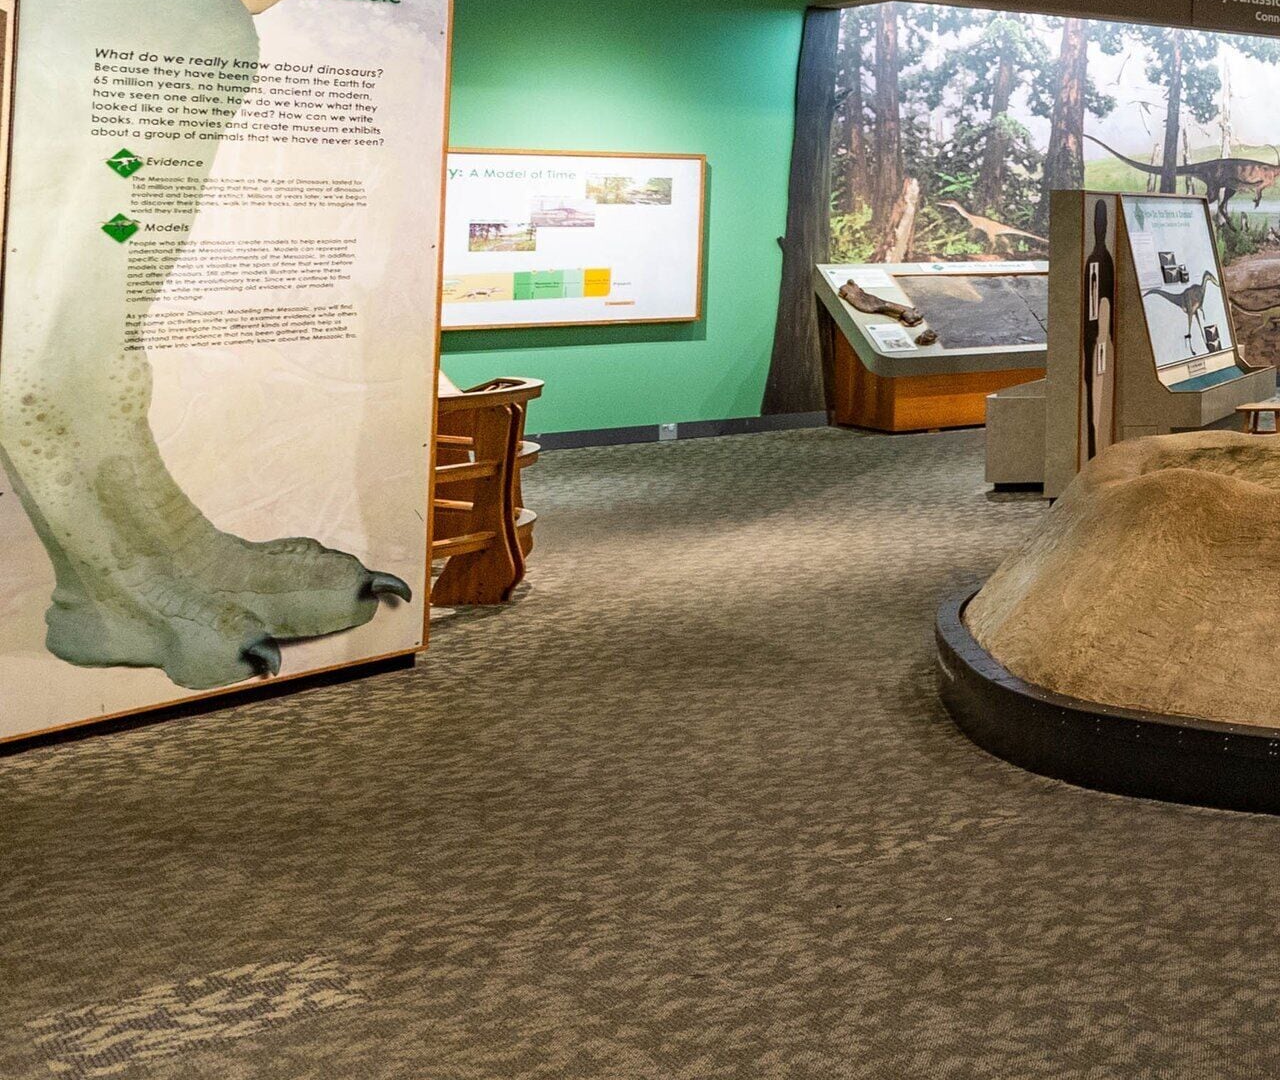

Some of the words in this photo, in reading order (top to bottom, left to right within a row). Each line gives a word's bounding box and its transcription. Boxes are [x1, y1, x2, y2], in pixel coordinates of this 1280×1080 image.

[95, 48, 134, 60] What
[138, 51, 158, 62] do
[163, 55, 184, 64] we
[188, 57, 228, 69] really
[232, 58, 269, 69] know
[274, 62, 313, 72] about
[316, 65, 383, 77] dinosaurs?
[94, 62, 149, 74] Because
[153, 66, 180, 77] they
[184, 68, 214, 78] have
[218, 70, 249, 80] been
[251, 74, 281, 83] gone
[285, 75, 310, 84] from
[313, 77, 330, 86] the
[333, 78, 359, 87] Earth
[361, 80, 375, 88] for
[93, 75, 108, 84] 65
[112, 77, 153, 86] million
[198, 83, 213, 91] no
[269, 87, 311, 96] ancient
[92, 88, 125, 98] have
[129, 92, 159, 100] seen
[163, 93, 187, 101] one
[190, 94, 223, 103] alive.
[255, 98, 270, 106] do
[294, 100, 323, 108] know
[326, 102, 352, 110] what
[355, 103, 377, 112] they
[92, 101, 137, 111] looked
[141, 103, 163, 113] like
[182, 105, 208, 114] how
[211, 107, 237, 117] they
[241, 109, 275, 118] lived?
[278, 111, 302, 119] How
[348, 115, 373, 123] write
[138, 117, 175, 126] make
[178, 119, 222, 128] movies
[224, 121, 248, 129] and
[341, 126, 380, 134] exhibits
[90, 127, 128, 136] about
[144, 131, 180, 140] group
[183, 130, 196, 139] of
[198, 131, 244, 141] animals
[247, 133, 269, 142] that
[291, 135, 318, 143] have
[354, 137, 384, 145] seen?
[146, 157, 204, 167] Evidence
[469, 168, 480, 177] A
[484, 169, 526, 178] Model
[529, 170, 542, 179] of
[547, 169, 576, 179] Time
[144, 223, 190, 232] Models
